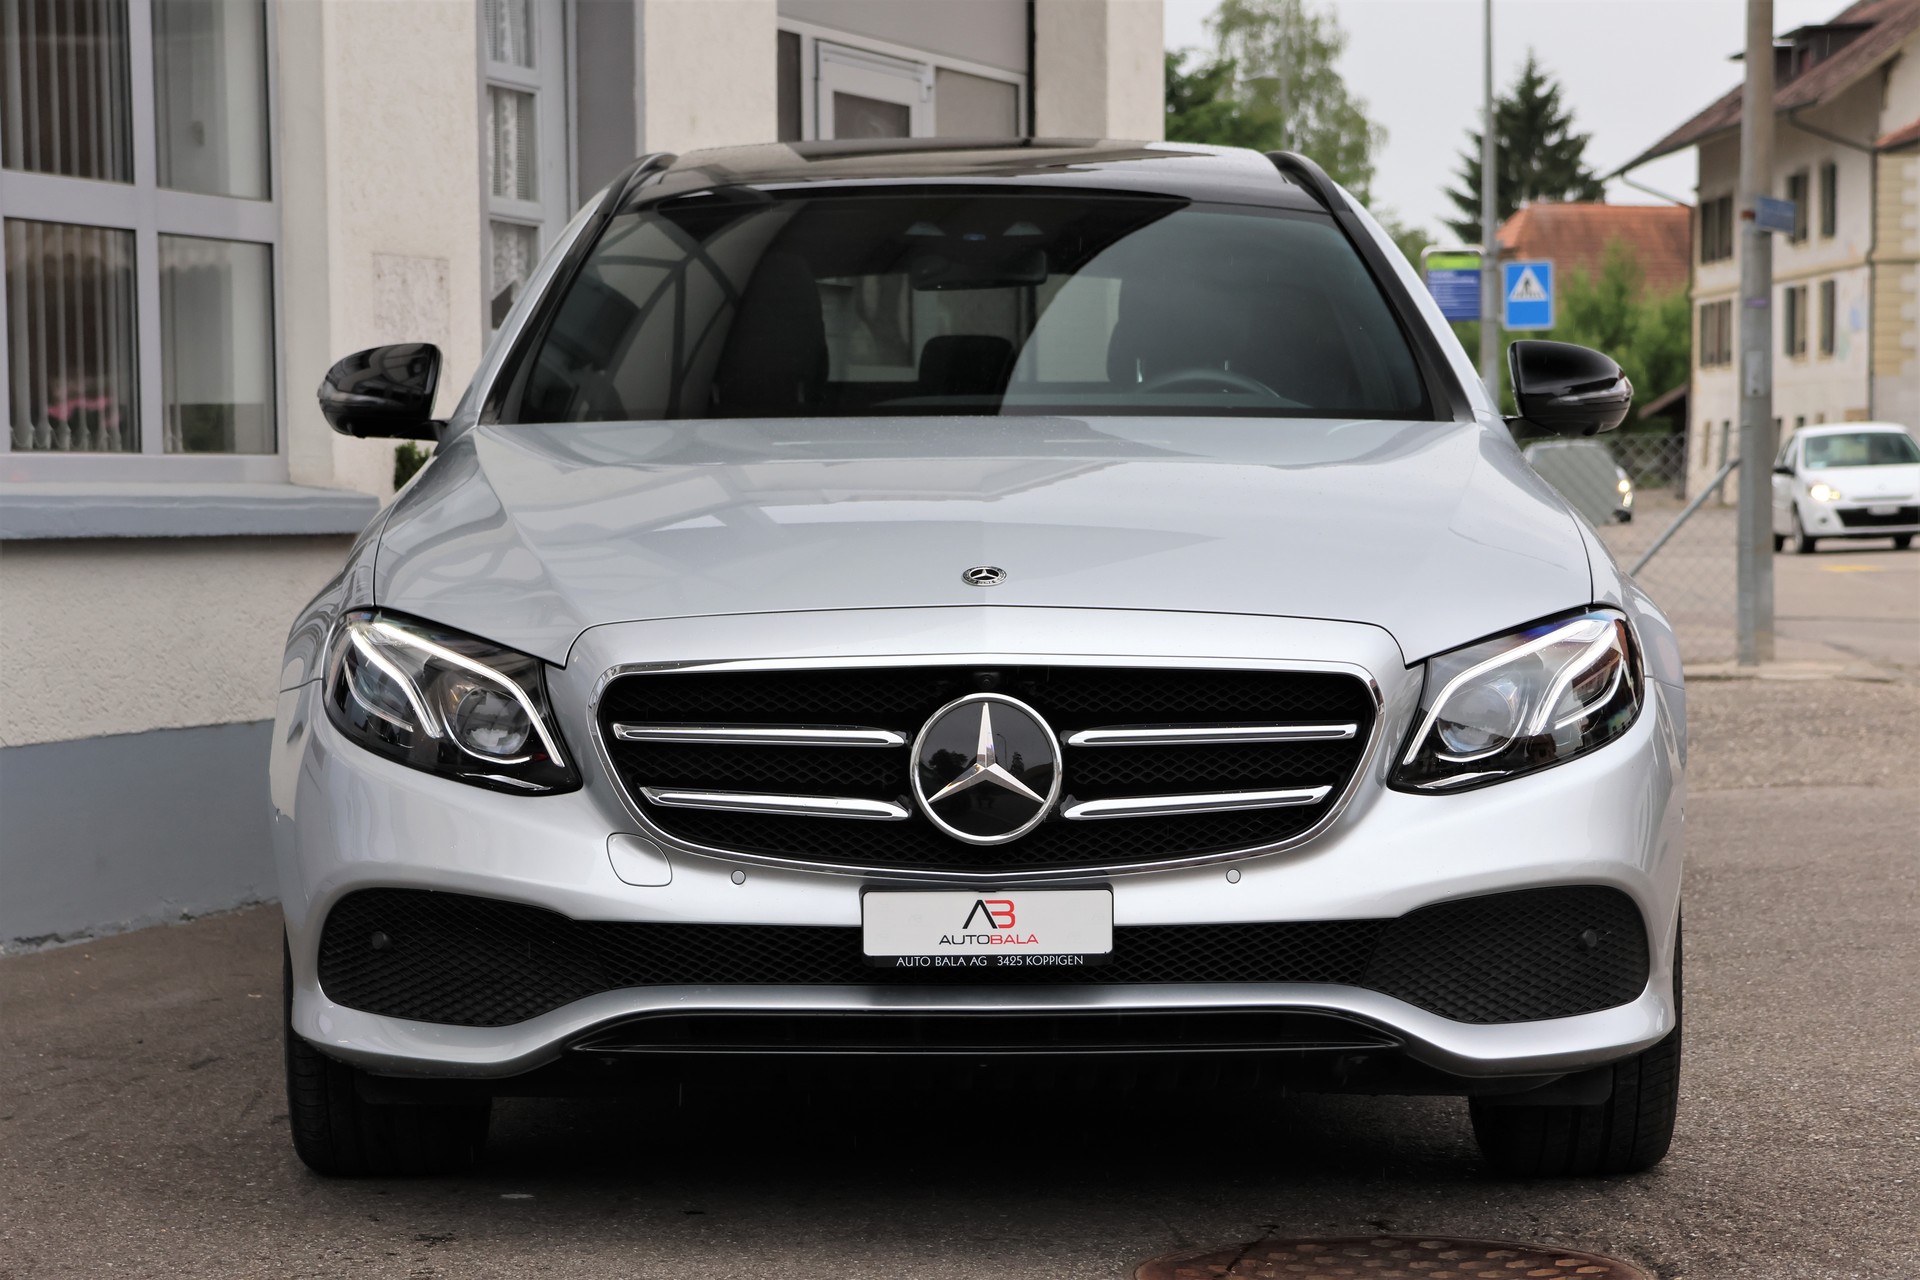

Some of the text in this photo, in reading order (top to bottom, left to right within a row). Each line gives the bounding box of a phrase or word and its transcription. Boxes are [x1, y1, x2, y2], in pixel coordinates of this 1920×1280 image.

[938, 934, 1039, 946] AUTOBALA
[896, 955, 1084, 967] AUTO BALA AG 3425 KOPPIGEN
